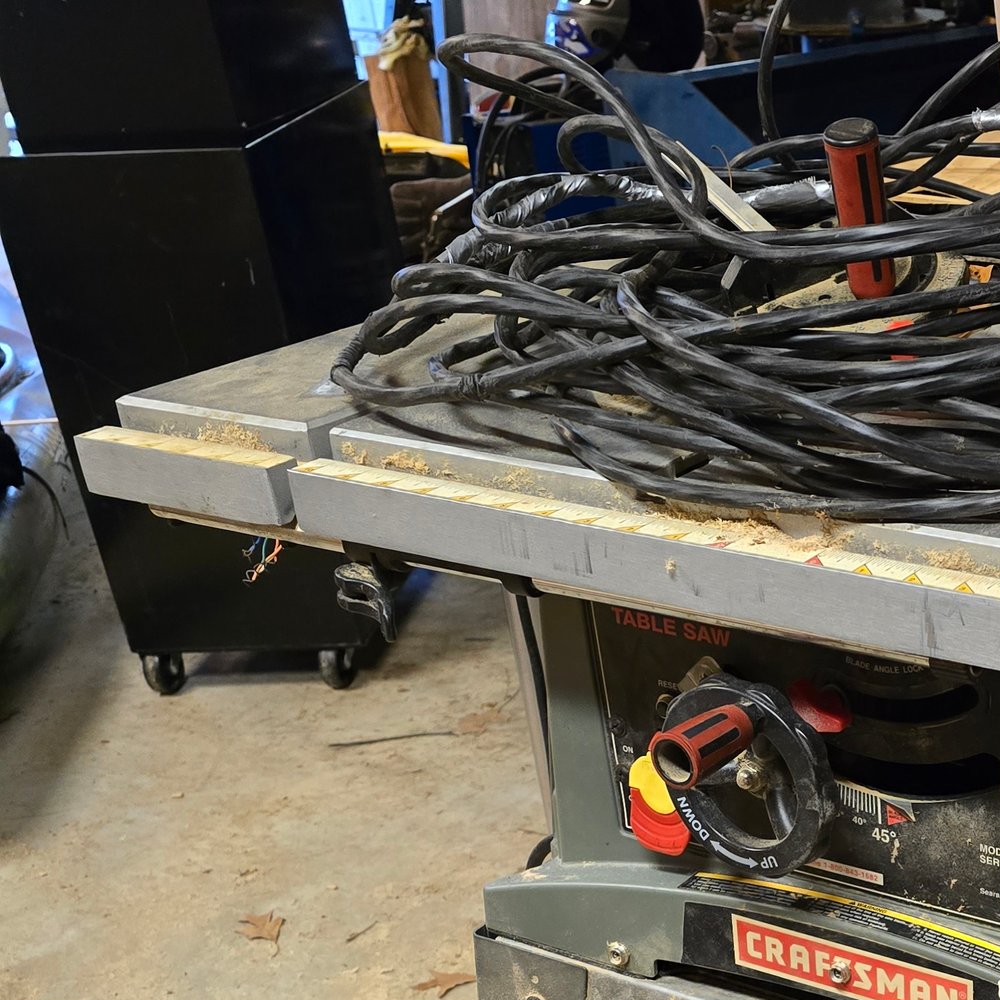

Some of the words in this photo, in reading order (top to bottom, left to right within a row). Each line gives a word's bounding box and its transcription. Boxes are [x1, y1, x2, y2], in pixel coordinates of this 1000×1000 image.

[611, 607, 677, 636] TABLE
[683, 623, 731, 647] SAW
[874, 664, 899, 673] ANGLE
[657, 680, 678, 690] RESE
[622, 745, 634, 754] ON
[677, 796, 710, 841] DOWN
[871, 827, 897, 843] 45°
[760, 855, 779, 869] UP
[856, 902, 888, 915] WARNING
